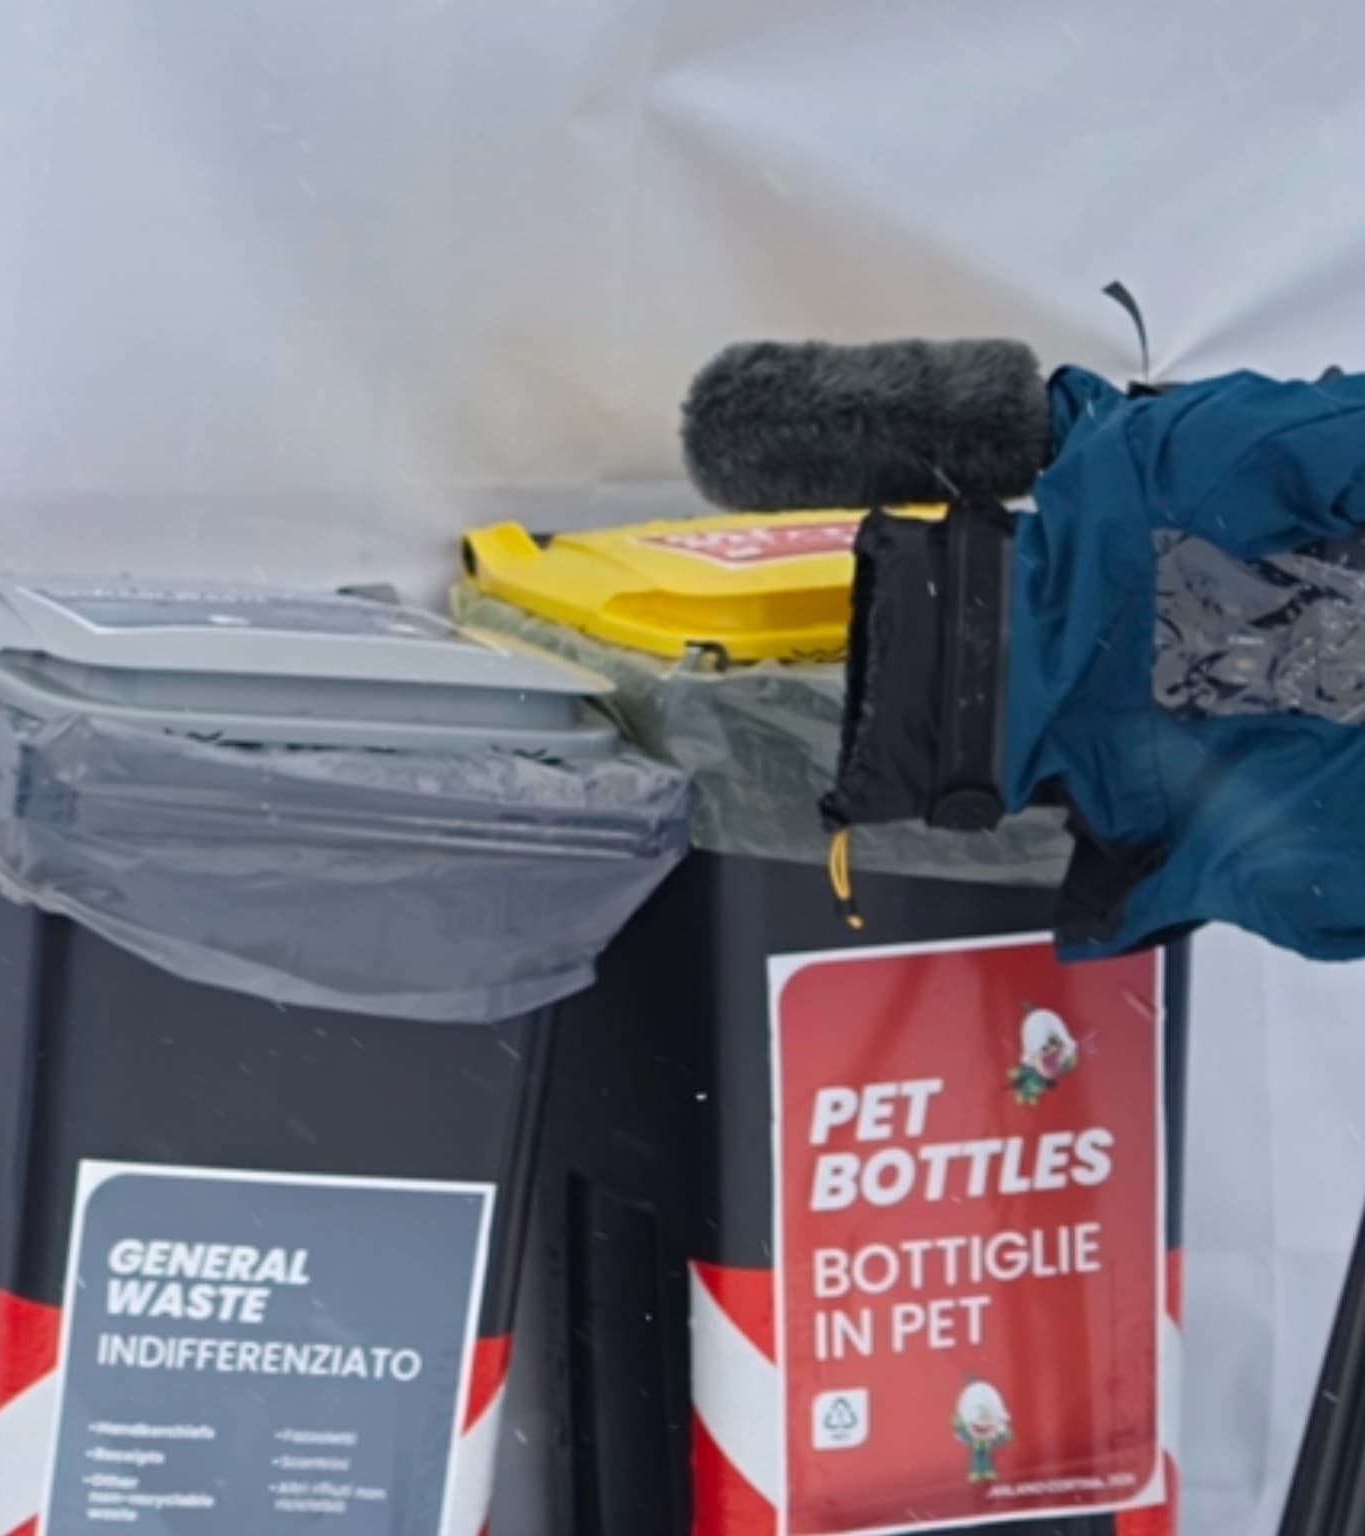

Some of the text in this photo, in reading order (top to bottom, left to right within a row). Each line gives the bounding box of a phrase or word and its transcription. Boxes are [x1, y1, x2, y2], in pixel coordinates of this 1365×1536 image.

[810, 1078, 943, 1146] PET
[810, 1128, 1115, 1212] BOTTLES
[107, 1238, 311, 1286] GENERAL
[814, 1223, 1102, 1298] BOTTIGLIE
[104, 1279, 270, 1324] WASTE
[814, 1295, 991, 1360] IN PET
[96, 1332, 423, 1382] INDIFFERENZIATO
